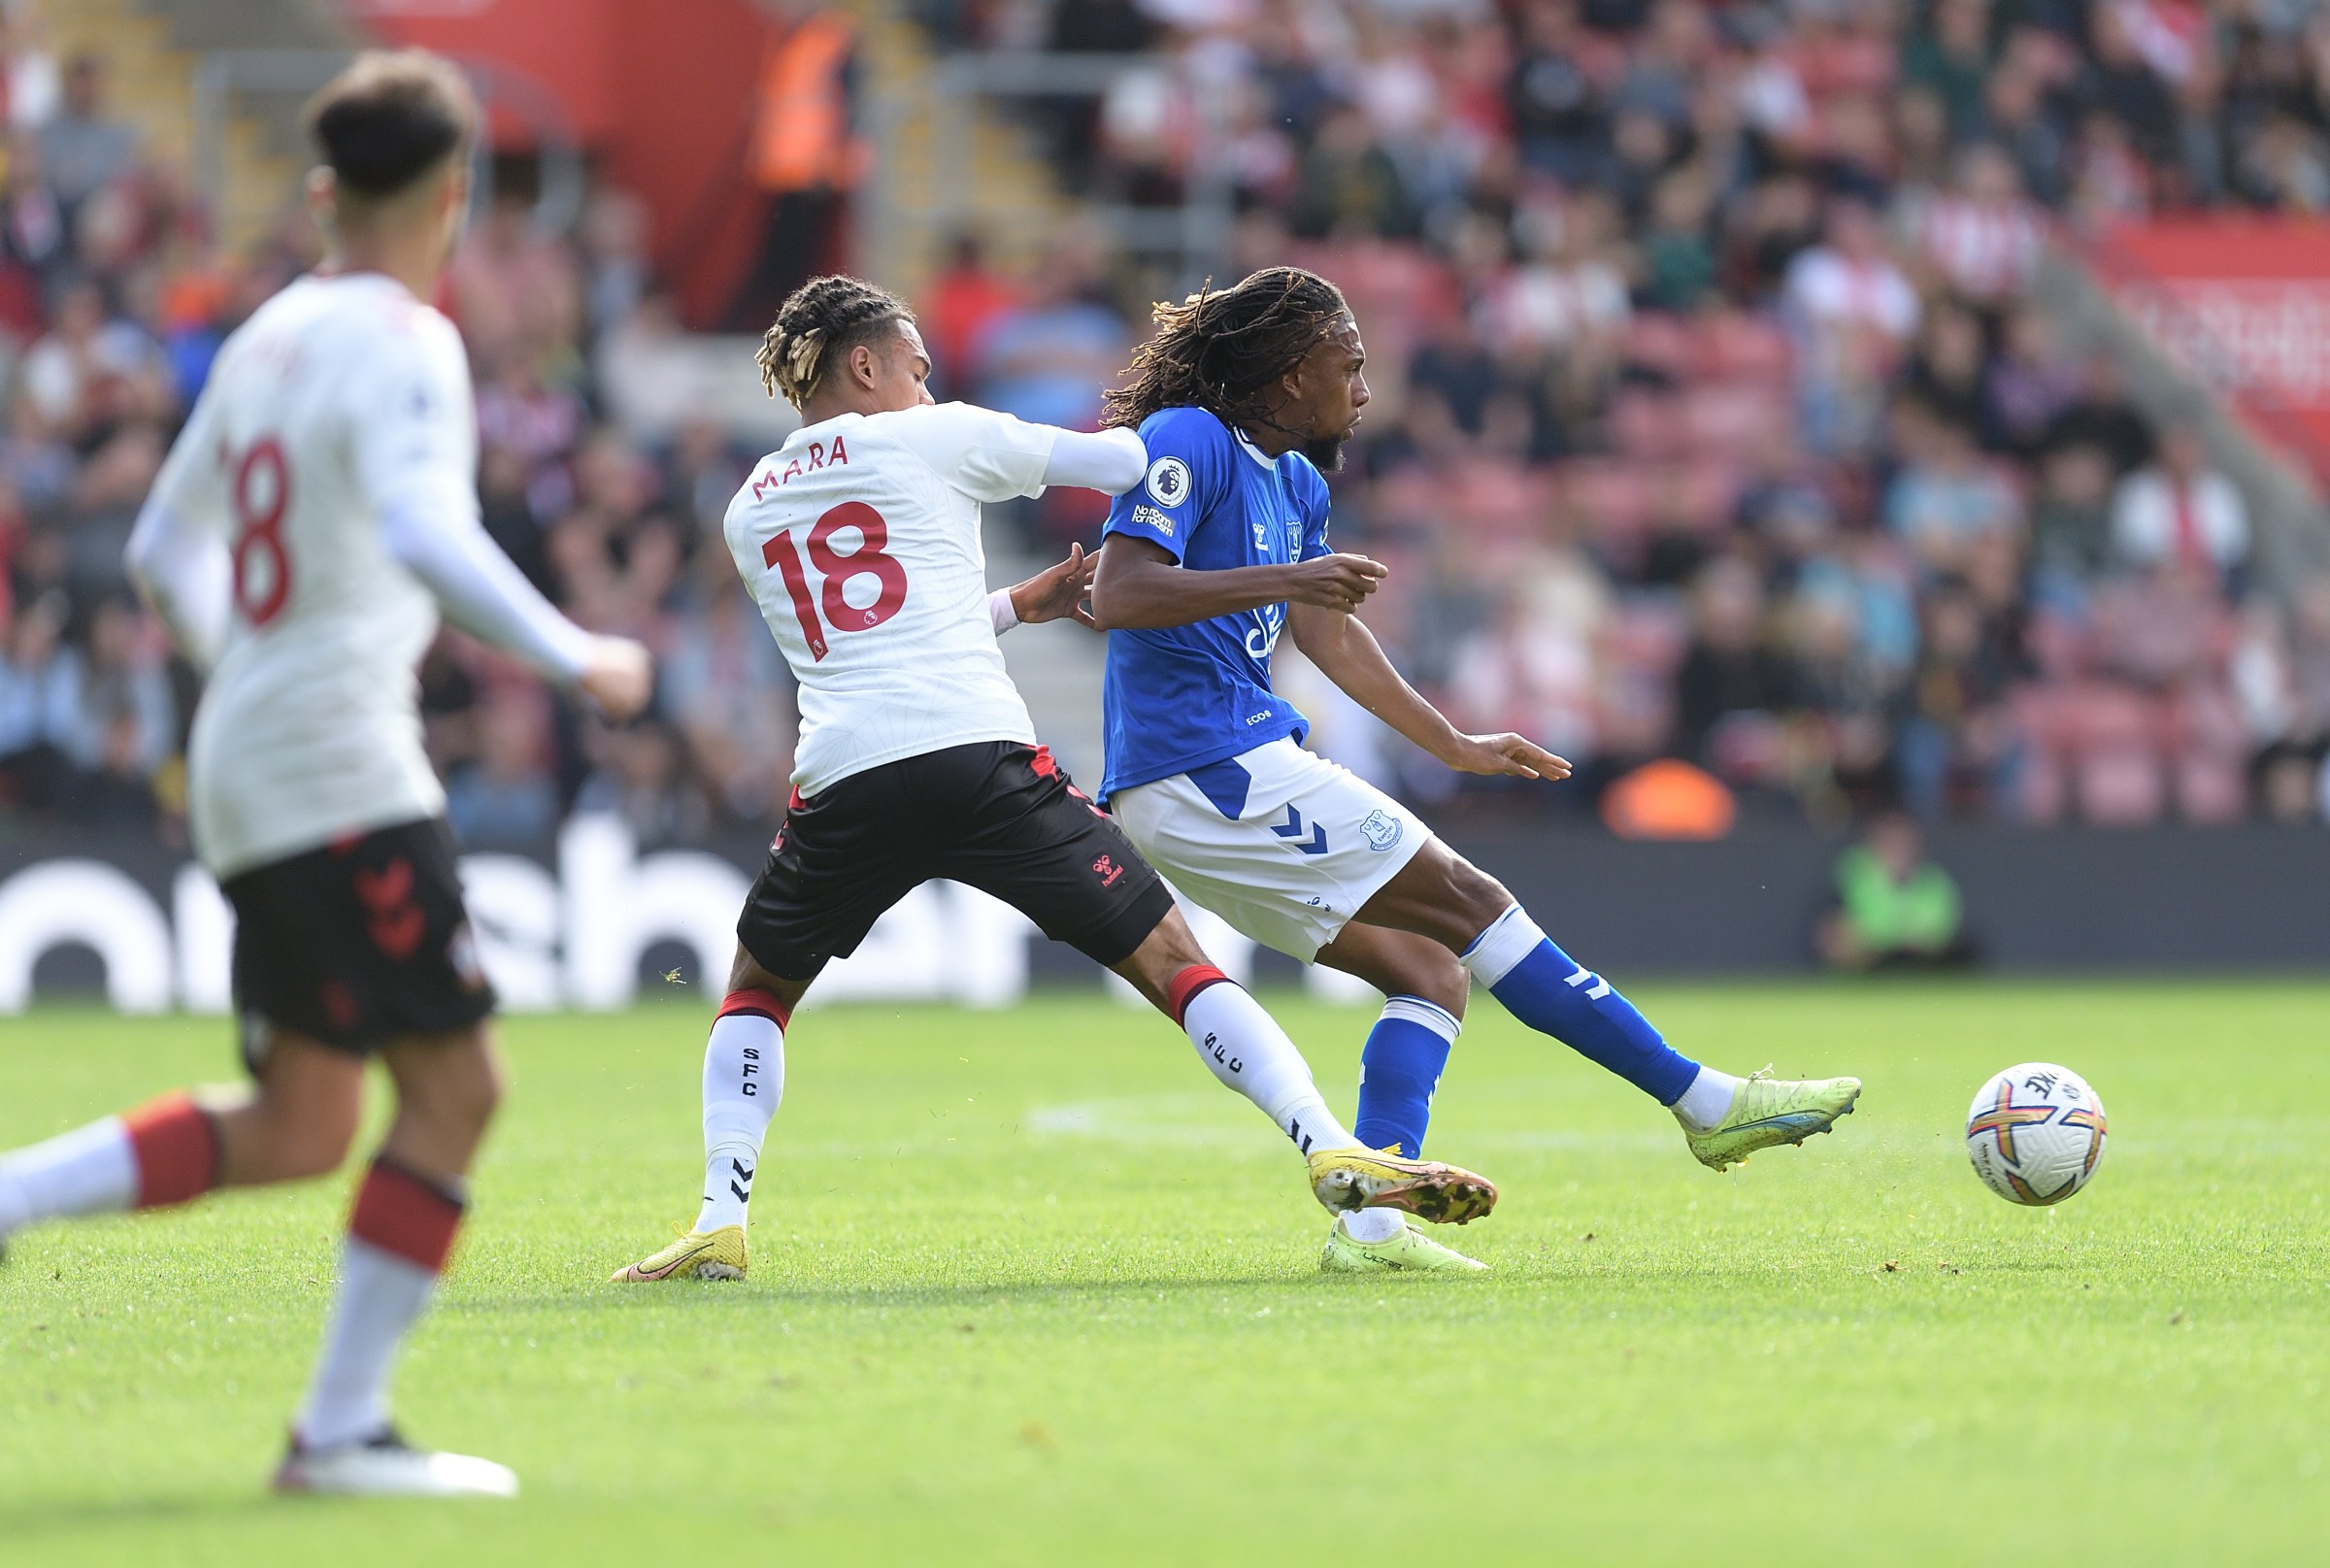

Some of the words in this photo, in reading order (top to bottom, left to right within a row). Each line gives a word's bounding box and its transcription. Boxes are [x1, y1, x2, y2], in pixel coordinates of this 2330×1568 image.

[751, 435, 849, 502] MARA
[1134, 504, 1148, 516] No
[1148, 508, 1172, 527] room
[1146, 515, 1174, 538] racism
[761, 500, 908, 663] 18
[1101, 864, 1123, 887] hummel
[742, 1048, 760, 1096] SFC
[1204, 1031, 1243, 1073] SFC
